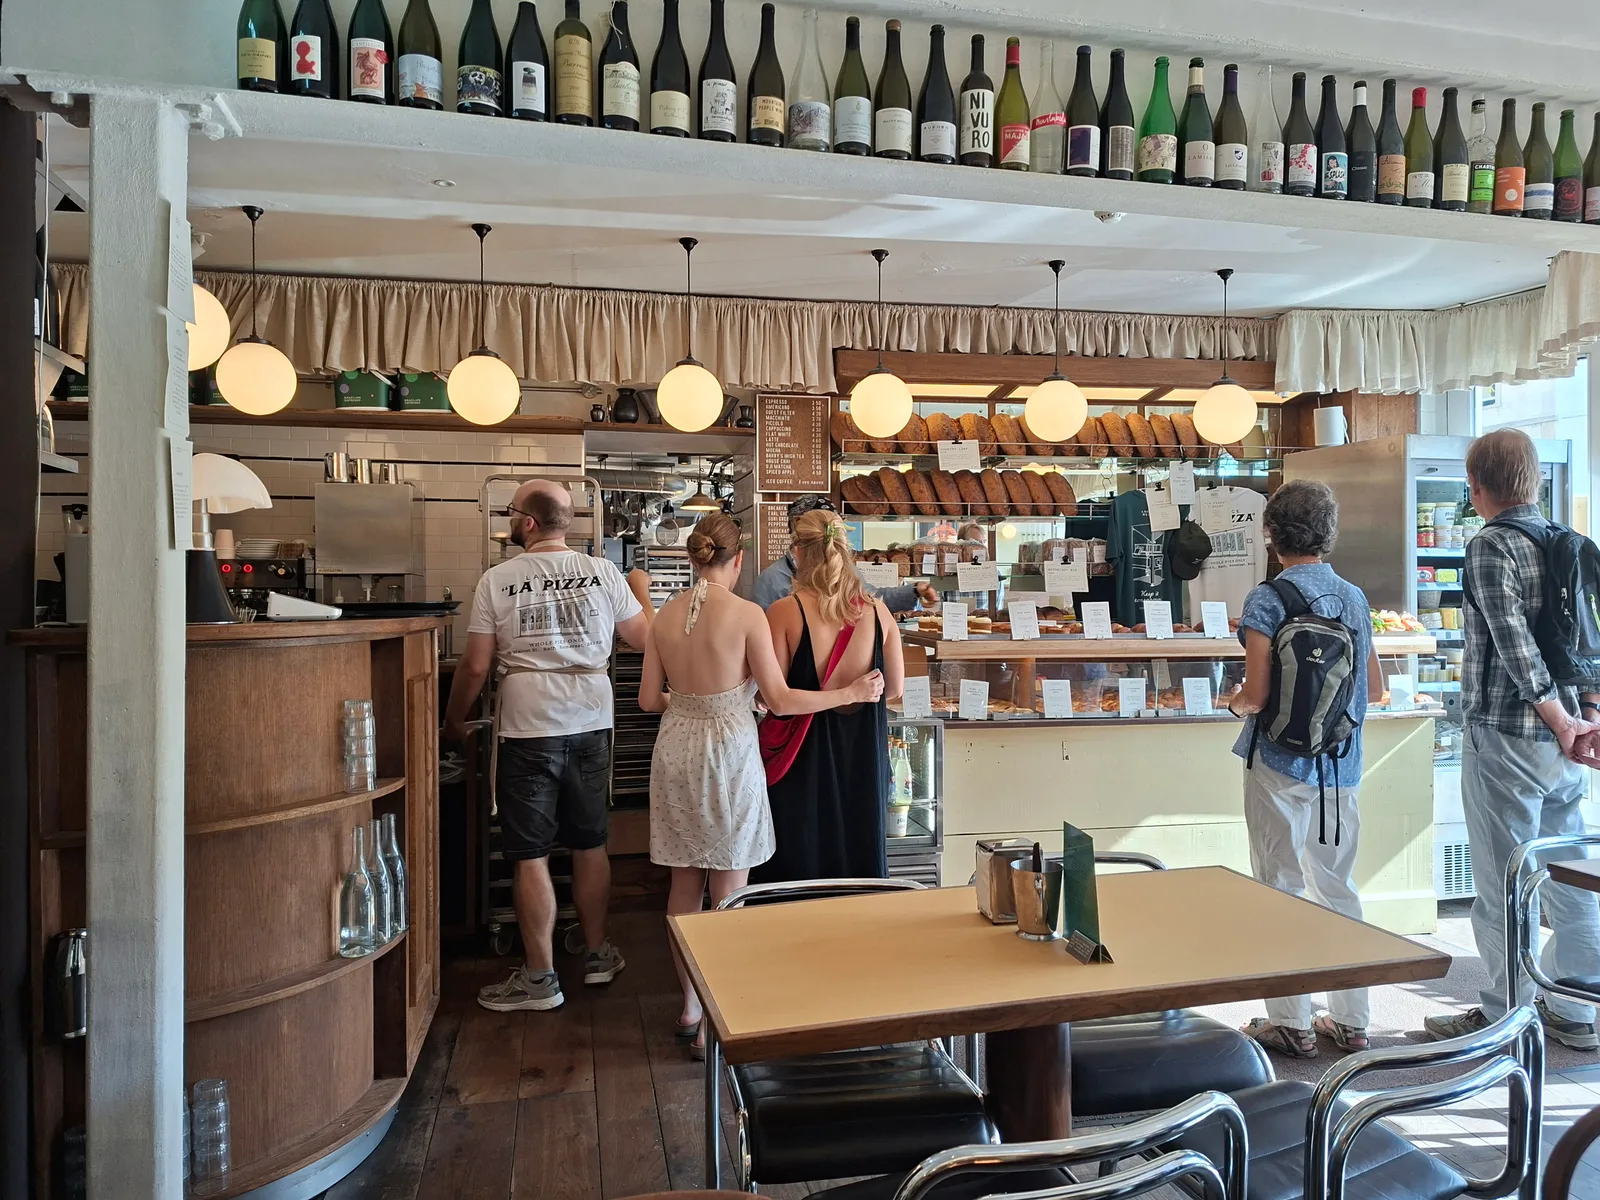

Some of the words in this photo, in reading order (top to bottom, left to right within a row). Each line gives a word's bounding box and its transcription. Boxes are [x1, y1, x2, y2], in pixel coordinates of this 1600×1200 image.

[970, 92, 985, 110] NI
[971, 111, 989, 128] VU
[971, 130, 990, 148] RO
[526, 571, 581, 580] LANDRACE
[1305, 656, 1326, 665] deuter
